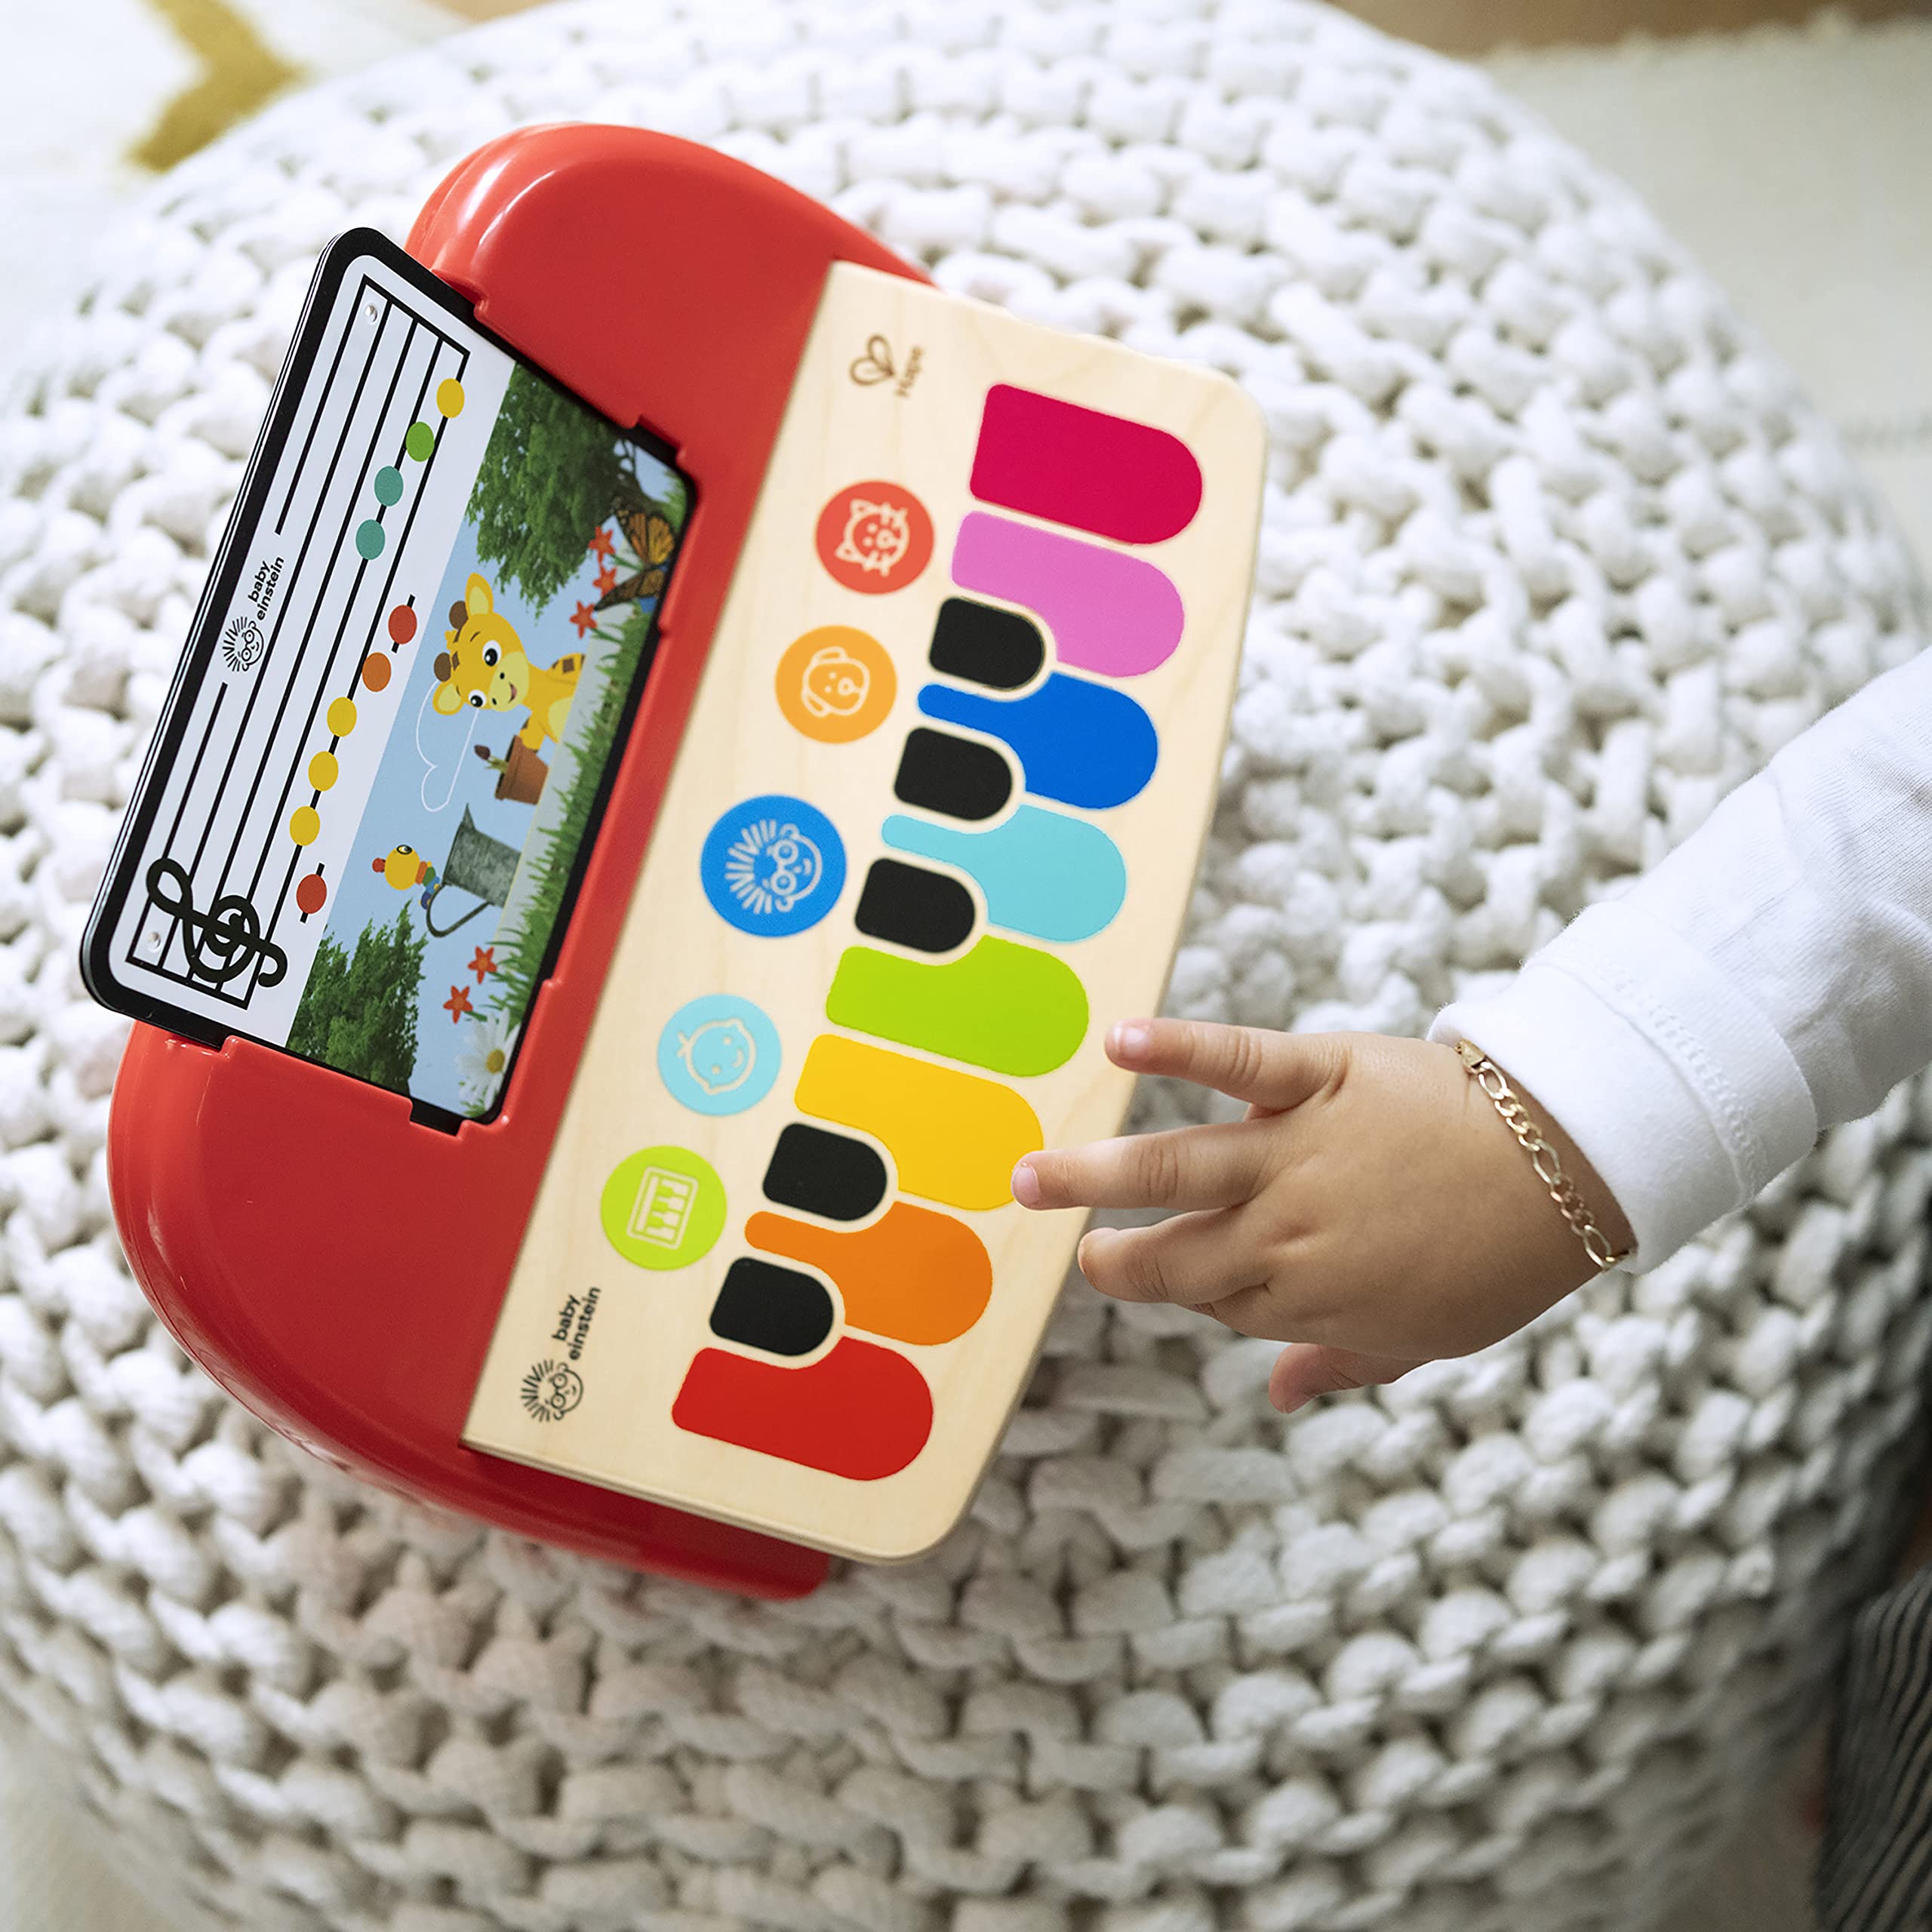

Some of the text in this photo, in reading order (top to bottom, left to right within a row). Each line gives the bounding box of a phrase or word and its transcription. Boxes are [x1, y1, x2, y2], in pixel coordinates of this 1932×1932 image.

[248, 561, 271, 602] baby
[257, 556, 285, 620] einstein
[551, 1294, 580, 1341] baby
[568, 1286, 601, 1360] einstein
